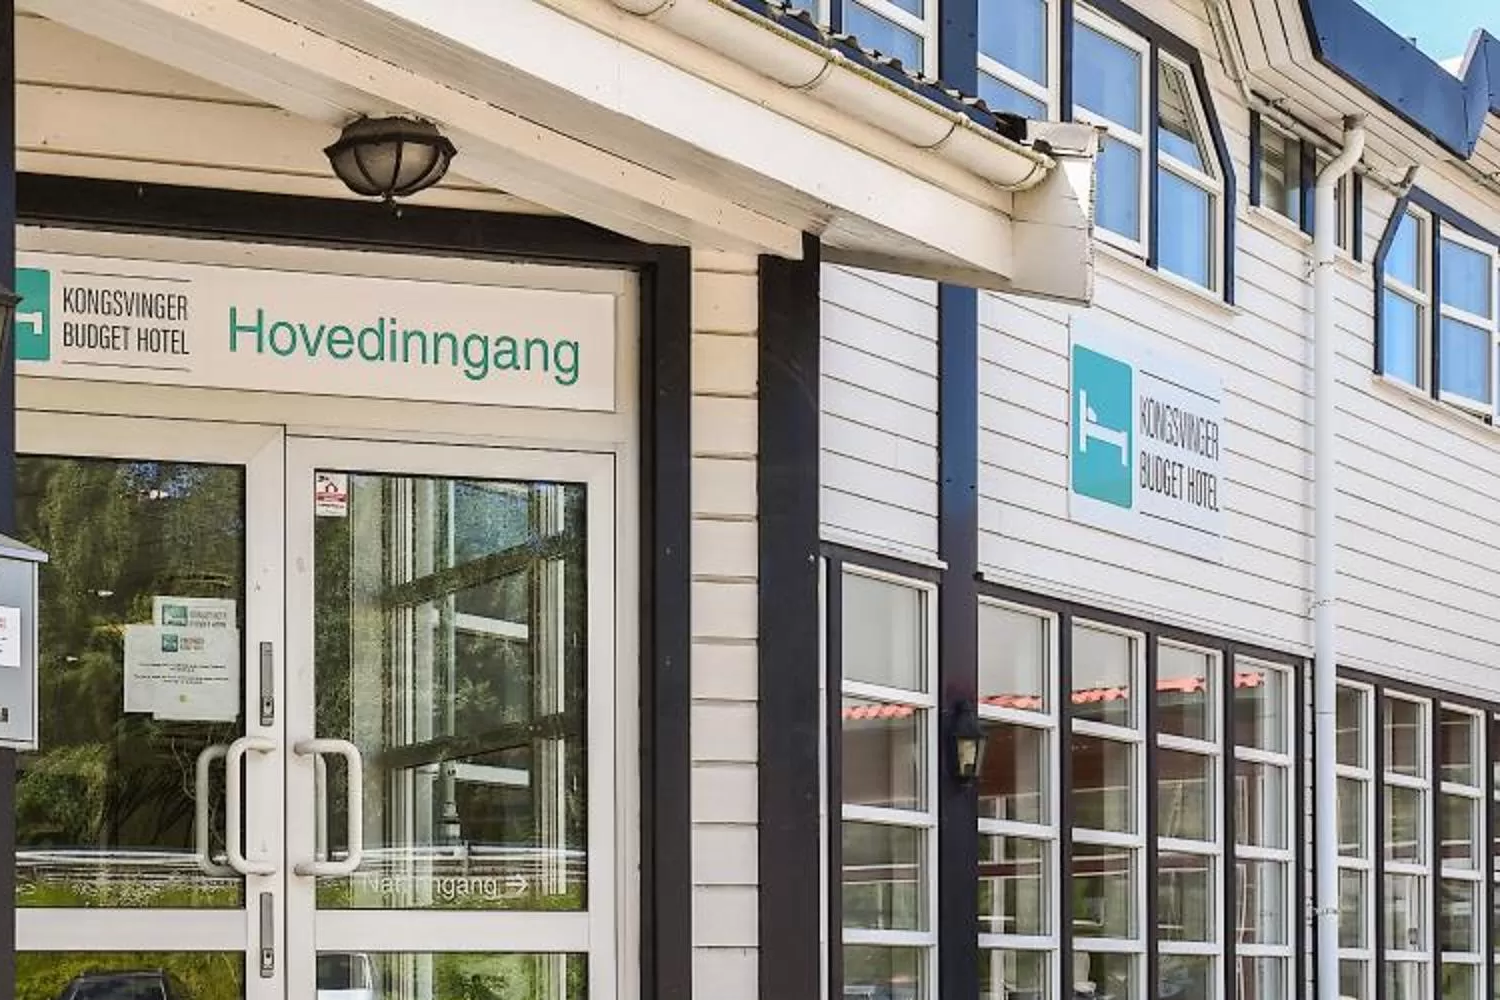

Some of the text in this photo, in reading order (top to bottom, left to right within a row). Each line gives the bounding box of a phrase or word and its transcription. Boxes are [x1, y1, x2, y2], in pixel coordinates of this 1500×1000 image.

[62, 286, 189, 322] KONGSVINGER
[62, 322, 190, 356] BUDGET HOTEL
[229, 306, 581, 386] Hovedinngang
[1140, 393, 1220, 462] KONGSVINGER
[1140, 450, 1220, 512] BUDGET HOTEL
